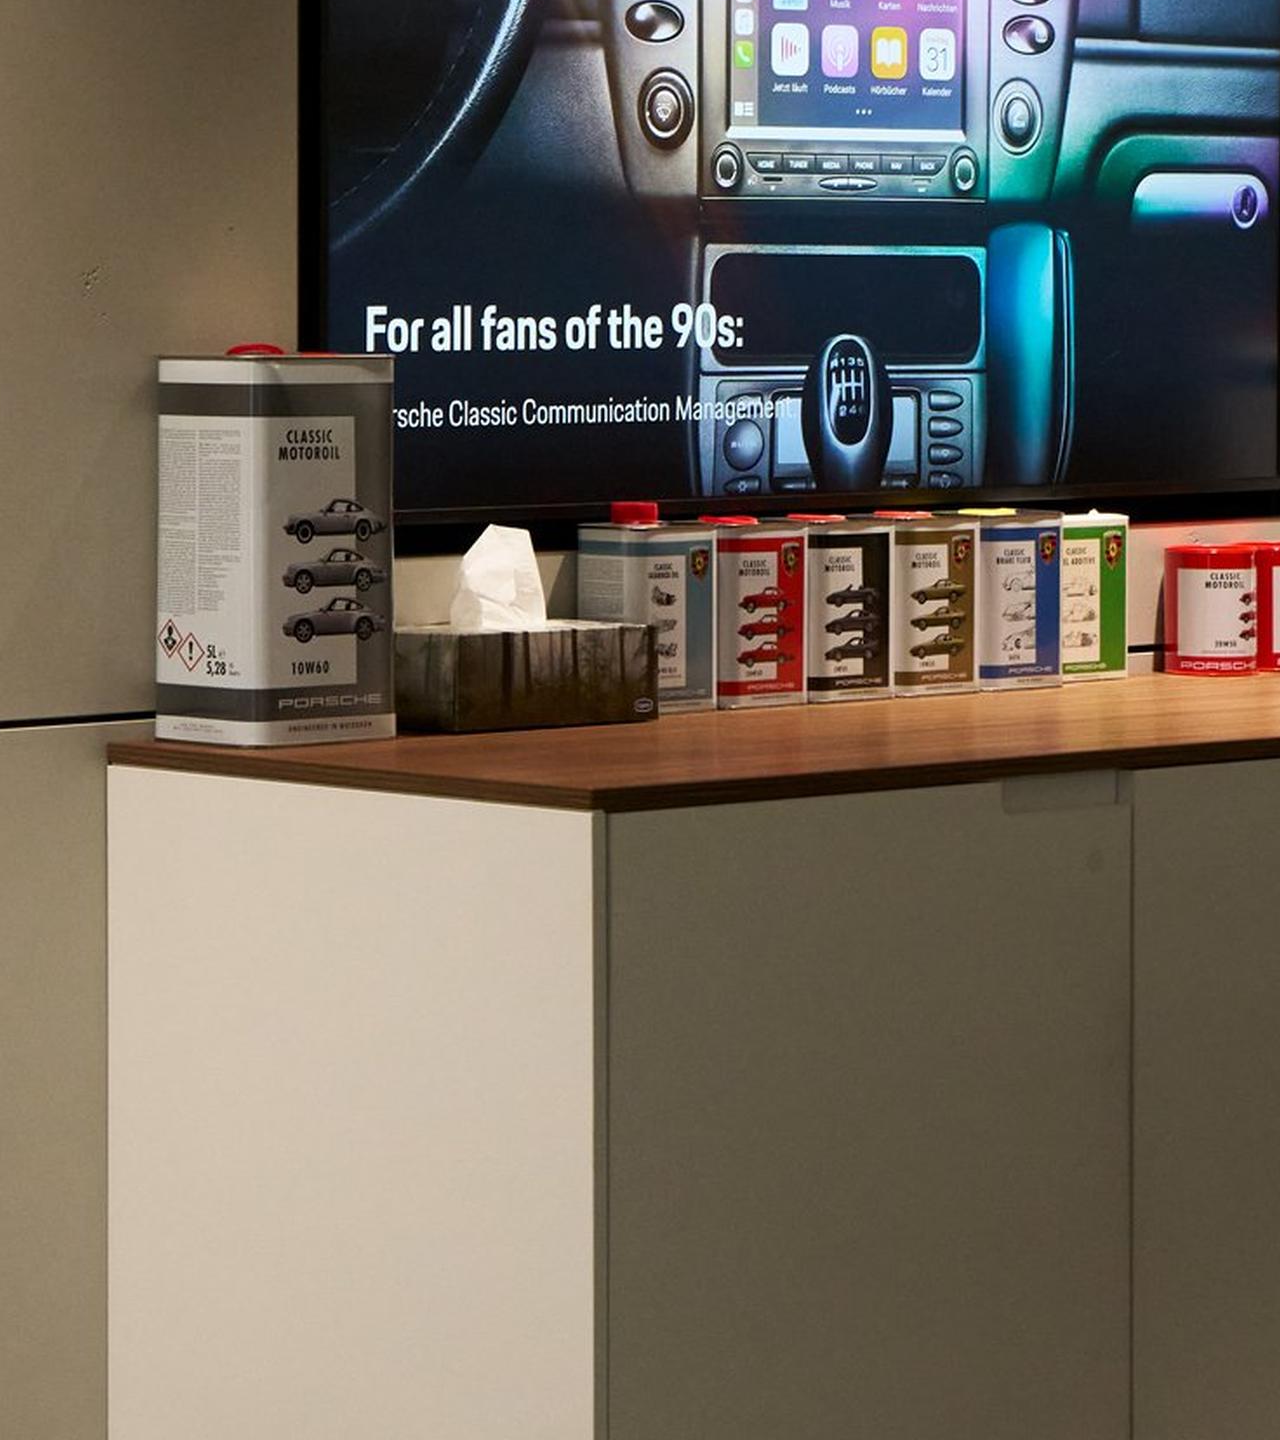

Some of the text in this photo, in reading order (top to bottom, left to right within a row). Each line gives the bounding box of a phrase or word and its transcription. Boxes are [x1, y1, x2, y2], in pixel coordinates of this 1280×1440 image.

[926, 46, 948, 73] 31
[365, 303, 744, 353] For all fans of the 90s:
[392, 400, 444, 428] sche
[449, 400, 517, 428] Classic
[522, 397, 670, 426] Communication
[286, 428, 333, 444] CLASSIC
[278, 446, 340, 461] MOTOROIL
[1209, 572, 1240, 581] CLASSIC
[1205, 581, 1245, 590] MOTOROIL
[206, 645, 218, 660] 5L
[206, 661, 227, 678] 5,28
[291, 660, 330, 676] 10W60
[1180, 661, 1256, 671] PORSC
[278, 693, 383, 711] PORSCHE
